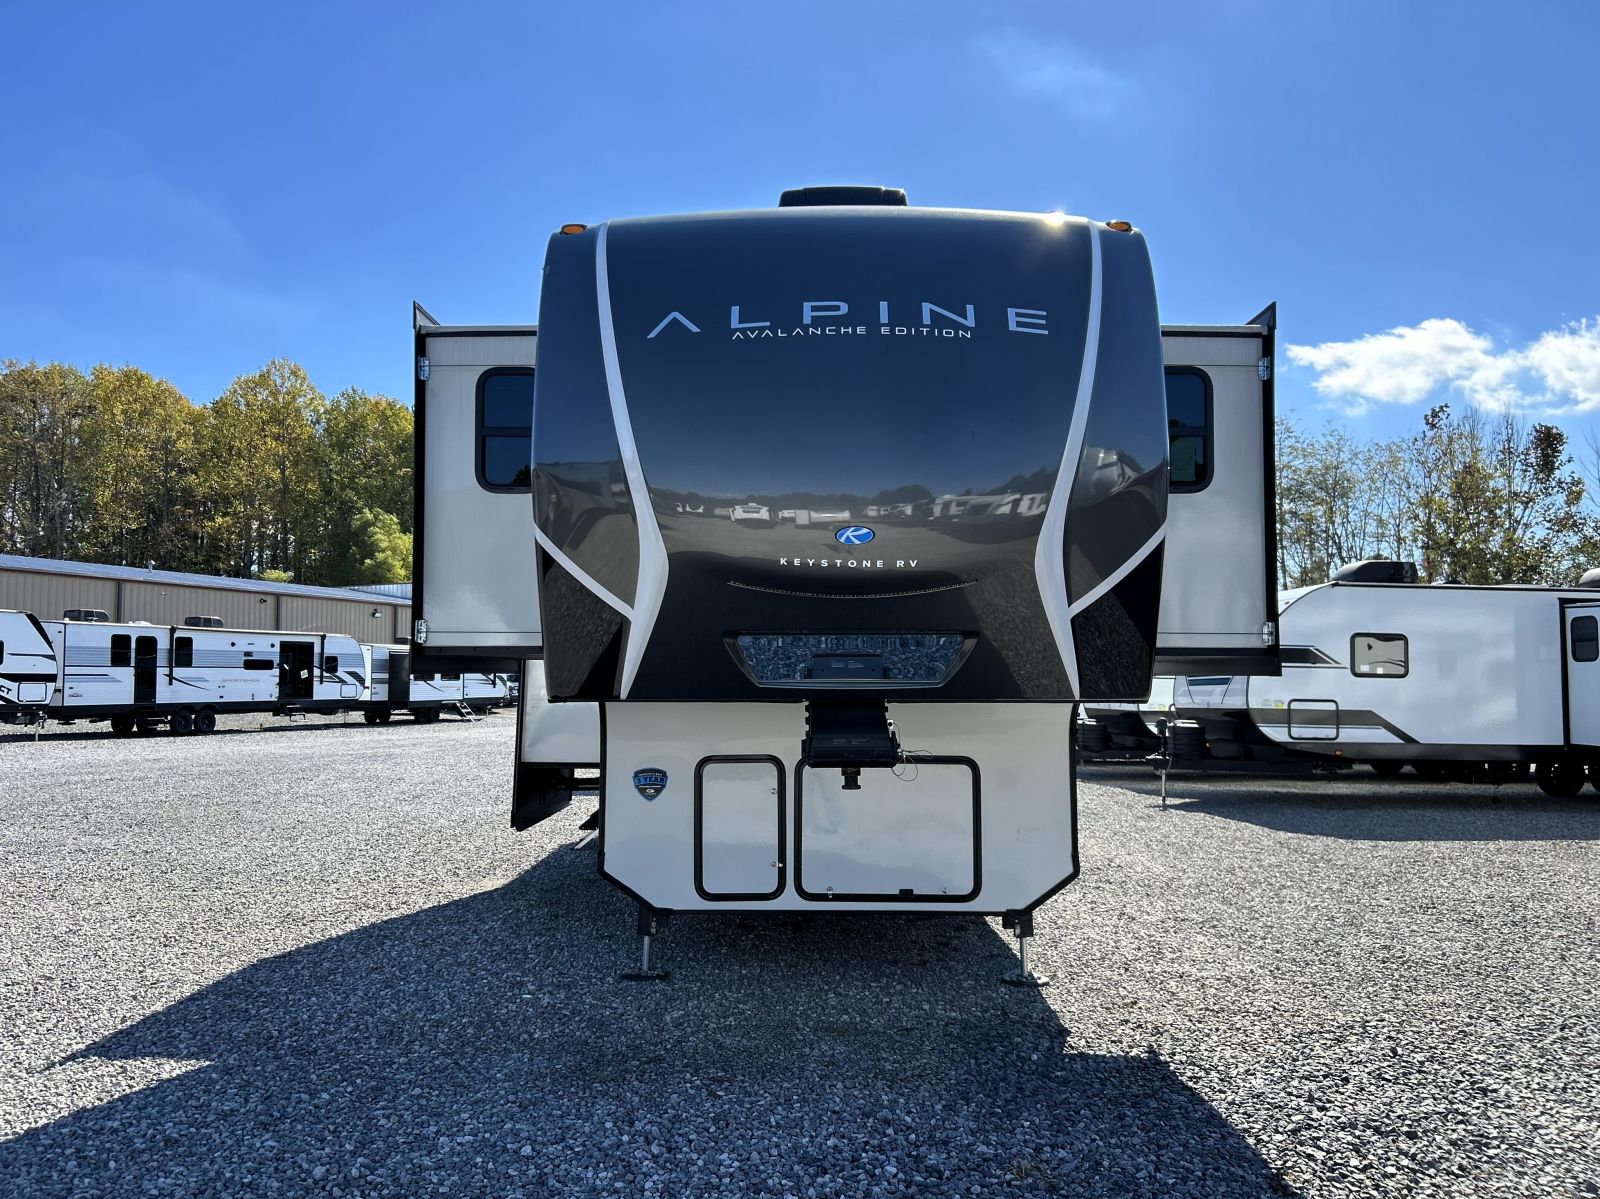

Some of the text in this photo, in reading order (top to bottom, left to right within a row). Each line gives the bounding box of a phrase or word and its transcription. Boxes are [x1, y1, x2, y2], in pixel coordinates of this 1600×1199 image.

[647, 301, 1049, 338] ALPINE
[732, 326, 971, 340] AVALANCHE EDITION
[780, 557, 918, 568] KEYSTONE RV
[643, 776, 665, 784] YEAR
